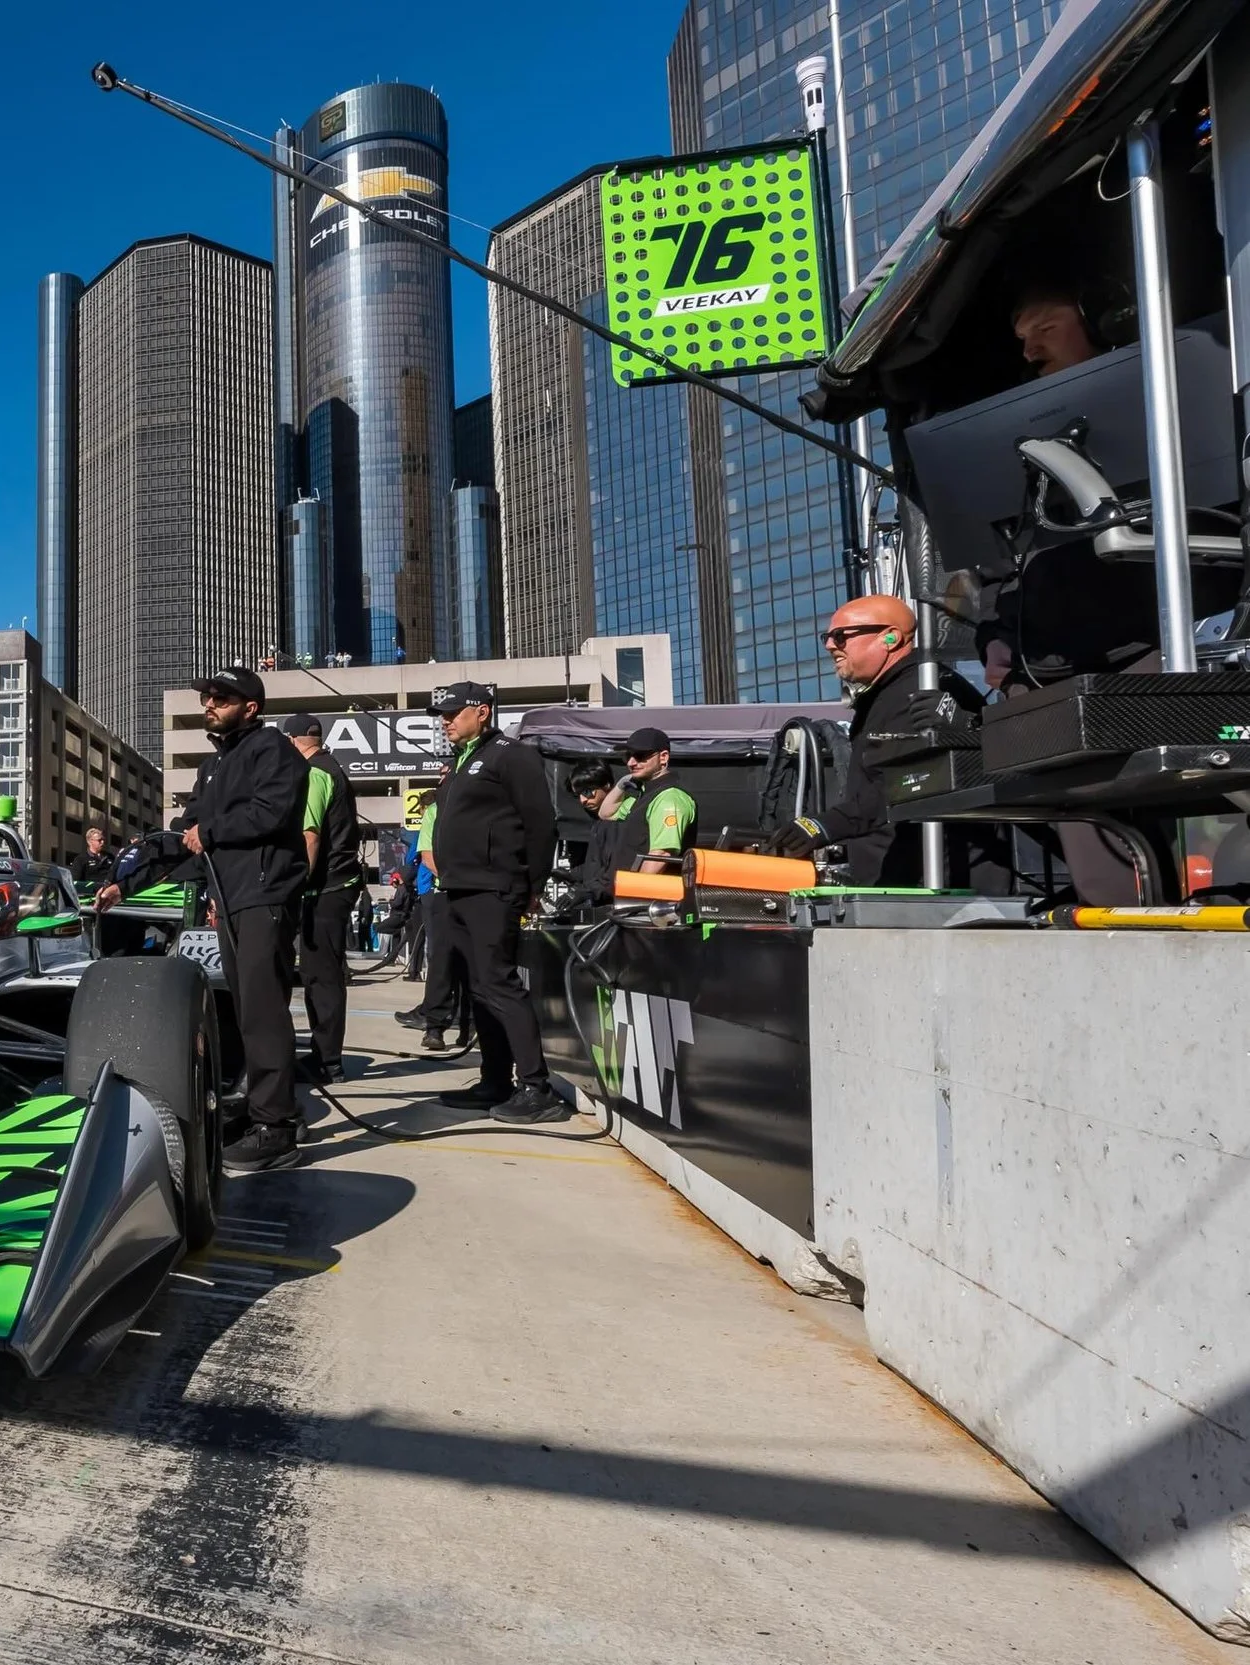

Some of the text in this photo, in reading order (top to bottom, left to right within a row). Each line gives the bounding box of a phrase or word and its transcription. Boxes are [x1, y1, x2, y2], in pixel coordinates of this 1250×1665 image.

[649, 211, 767, 290] 76
[665, 287, 760, 312] VEEKAY
[349, 761, 378, 771] CCI
[384, 762, 416, 771] Ventcon
